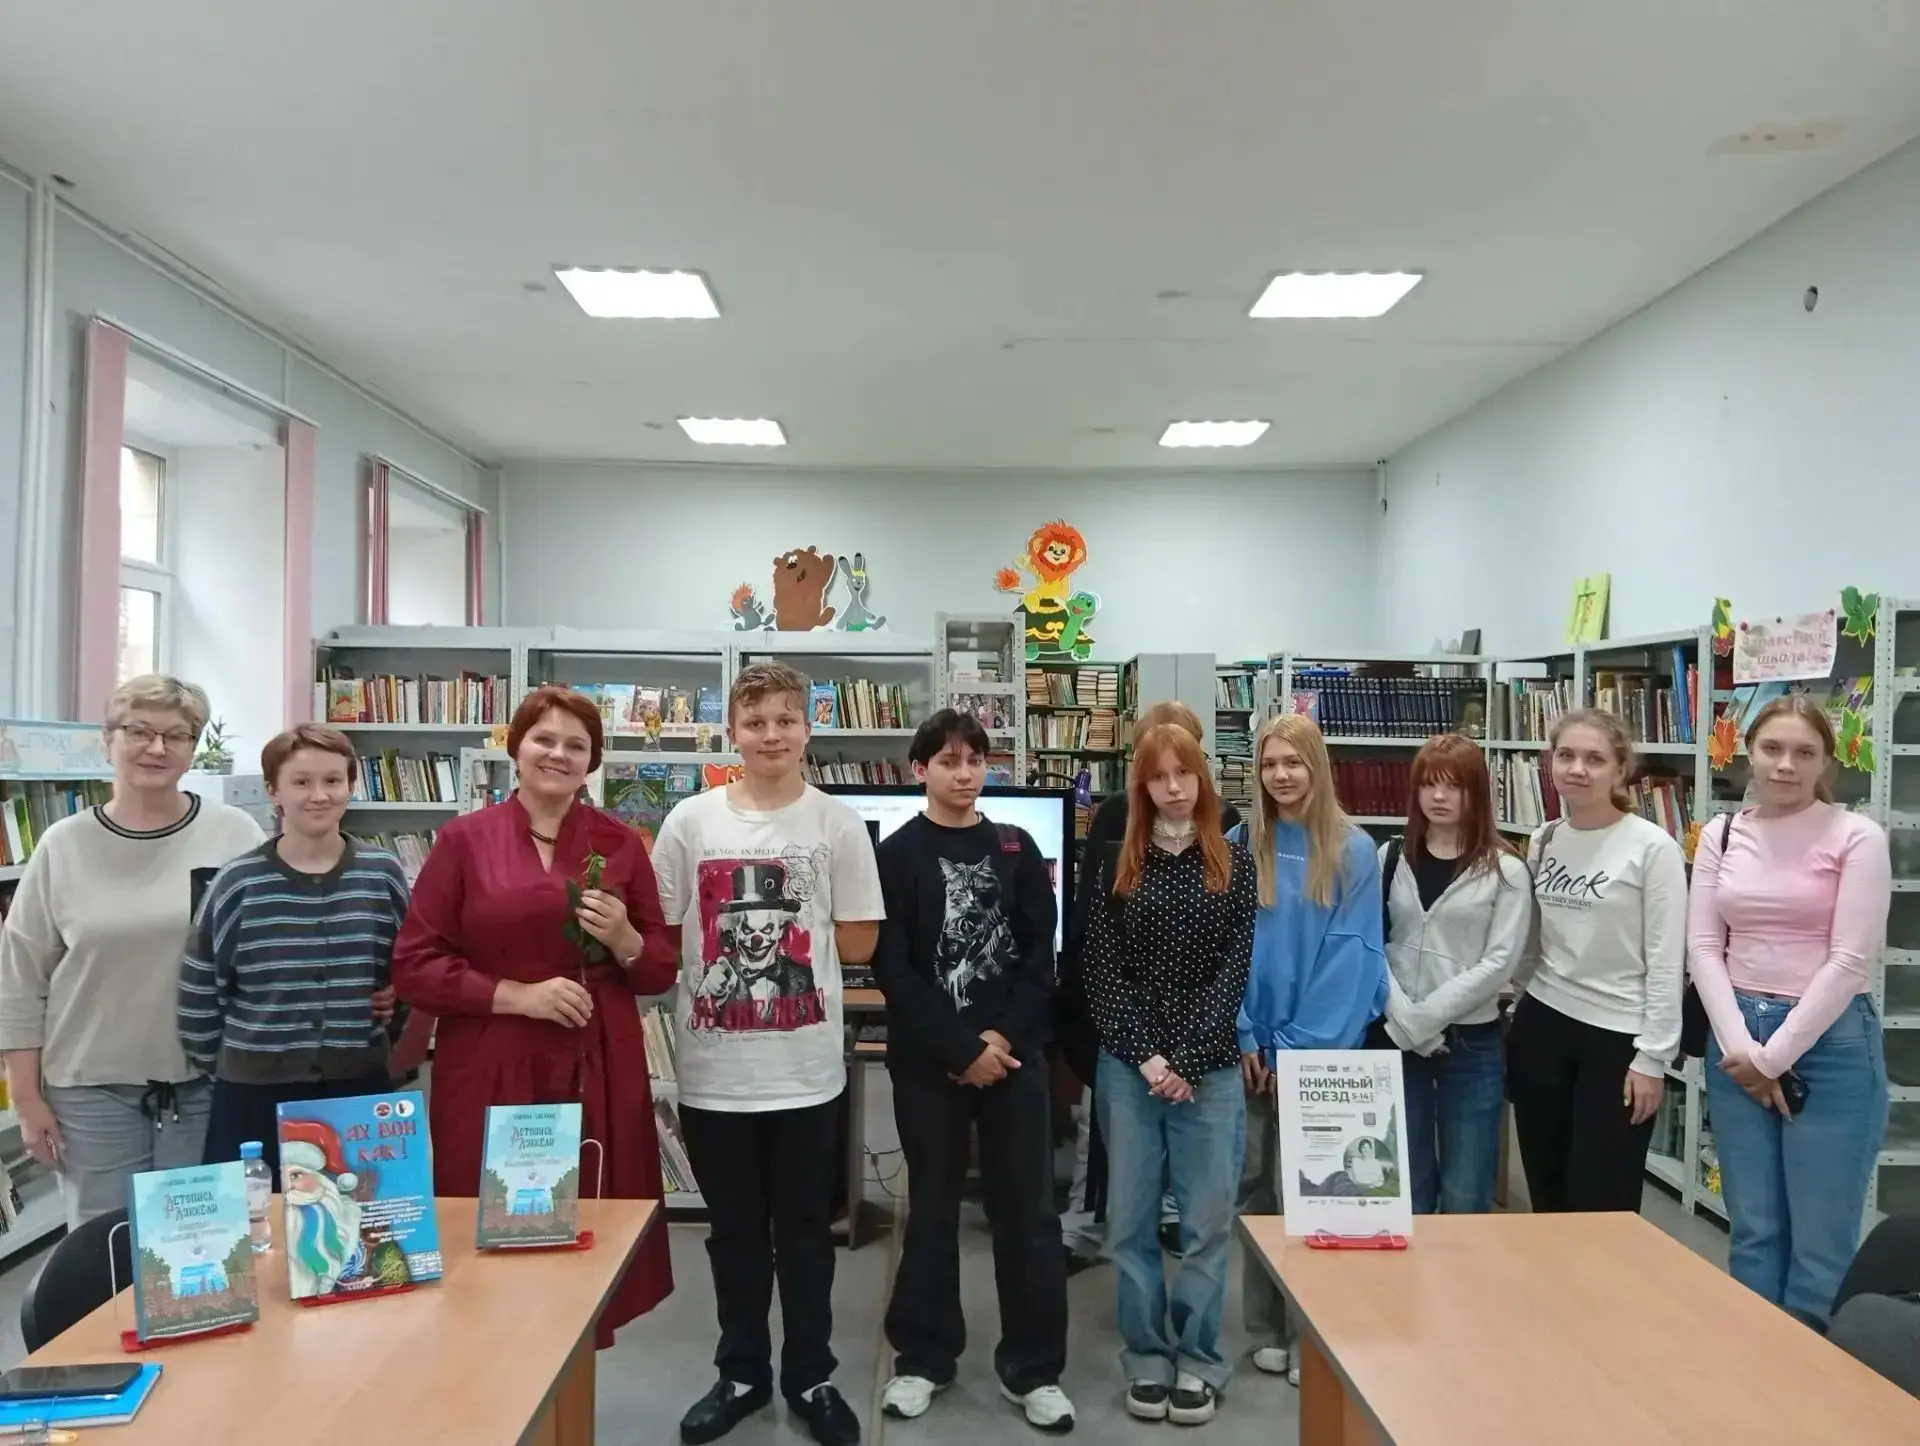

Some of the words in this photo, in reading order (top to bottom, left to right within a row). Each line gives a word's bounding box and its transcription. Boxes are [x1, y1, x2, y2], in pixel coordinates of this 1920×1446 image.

[1534, 857, 1609, 899] Black
[1299, 1076, 1373, 1089] КНИЖНЫЙ
[1299, 1090, 1351, 1104] ПОЕЗД
